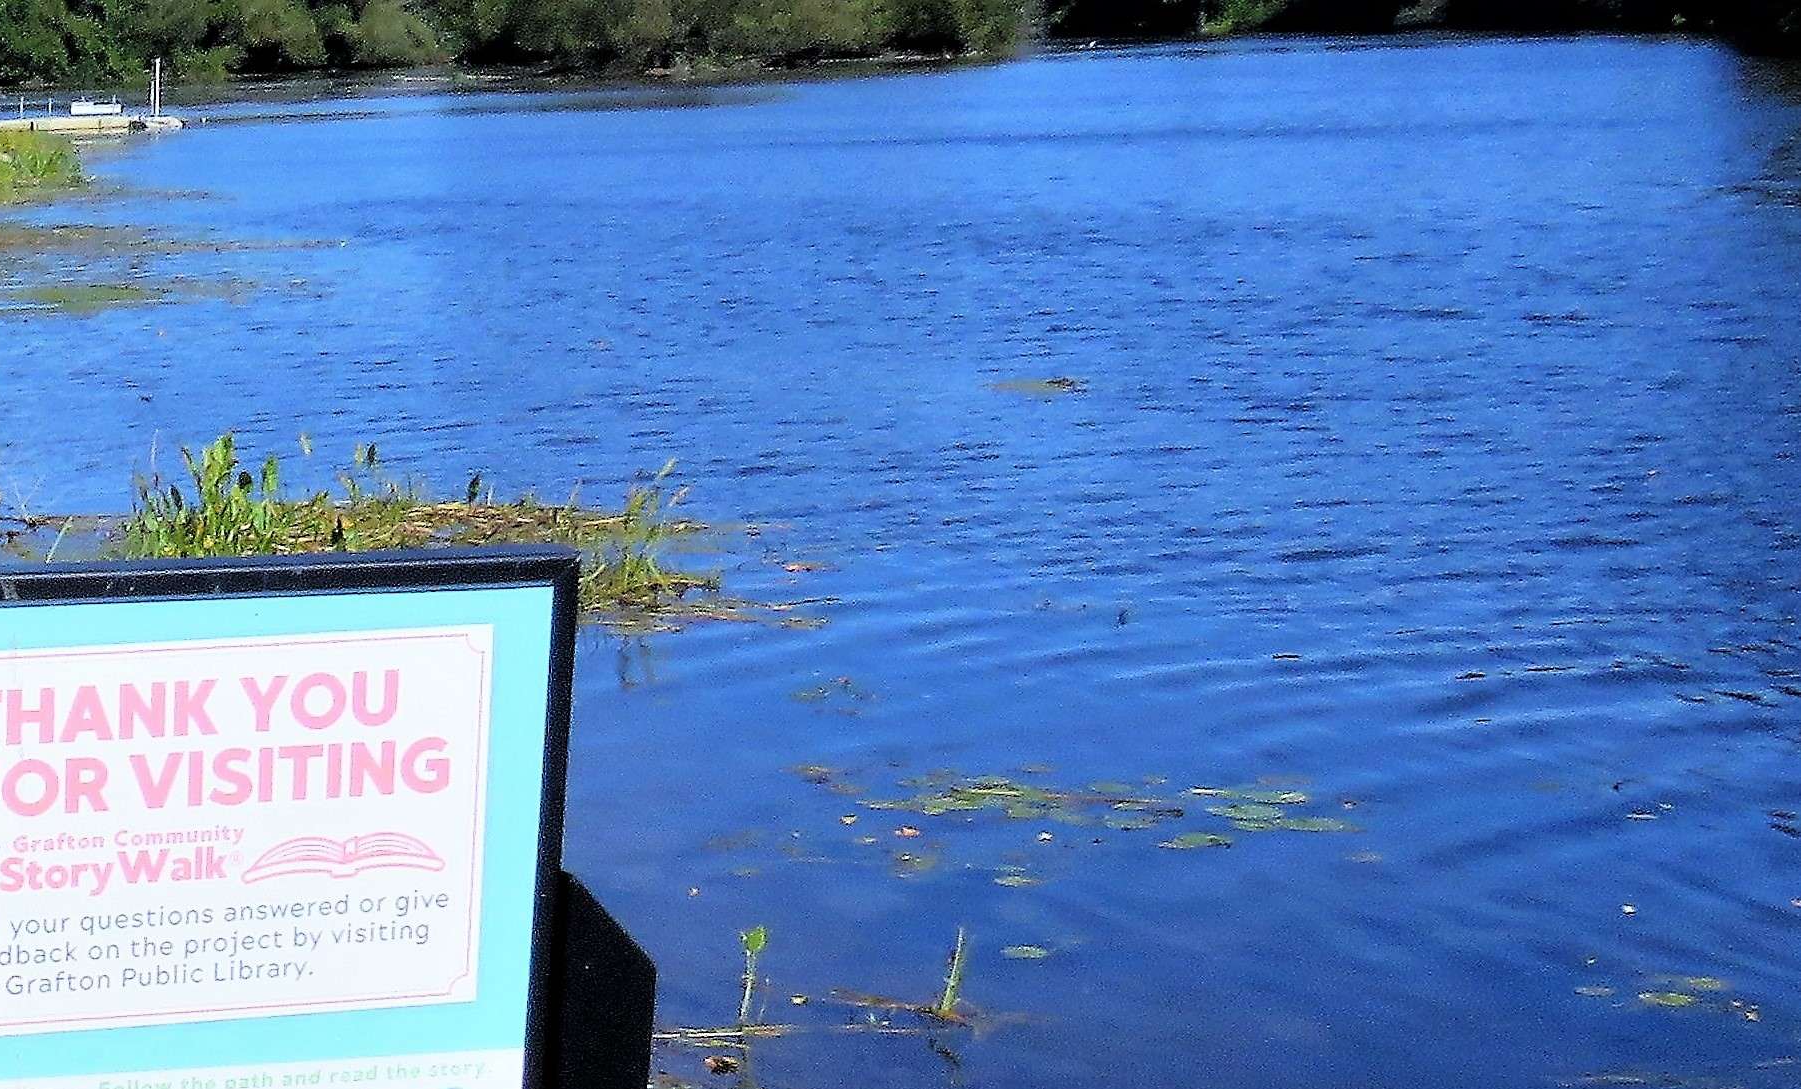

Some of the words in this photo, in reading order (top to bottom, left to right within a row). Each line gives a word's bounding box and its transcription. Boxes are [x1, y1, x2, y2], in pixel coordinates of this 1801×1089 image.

[239, 669, 399, 731] YOU
[129, 736, 451, 809] VISITING
[12, 833, 105, 853] Grafton
[113, 825, 245, 847] Community
[9, 915, 71, 939] your
[79, 904, 214, 933] questions
[223, 894, 350, 922] answered
[358, 897, 390, 915] or
[396, 889, 451, 917] give
[88, 940, 121, 960] on
[130, 935, 175, 958] the
[184, 928, 284, 959] project
[293, 924, 324, 951] by
[332, 918, 432, 947] visiting
[5, 967, 113, 997] Grafton
[121, 959, 204, 988] Public
[213, 955, 315, 983] Library.
[282, 1070, 322, 1087] and
[330, 1066, 378, 1083] read
[387, 1063, 421, 1079] the
